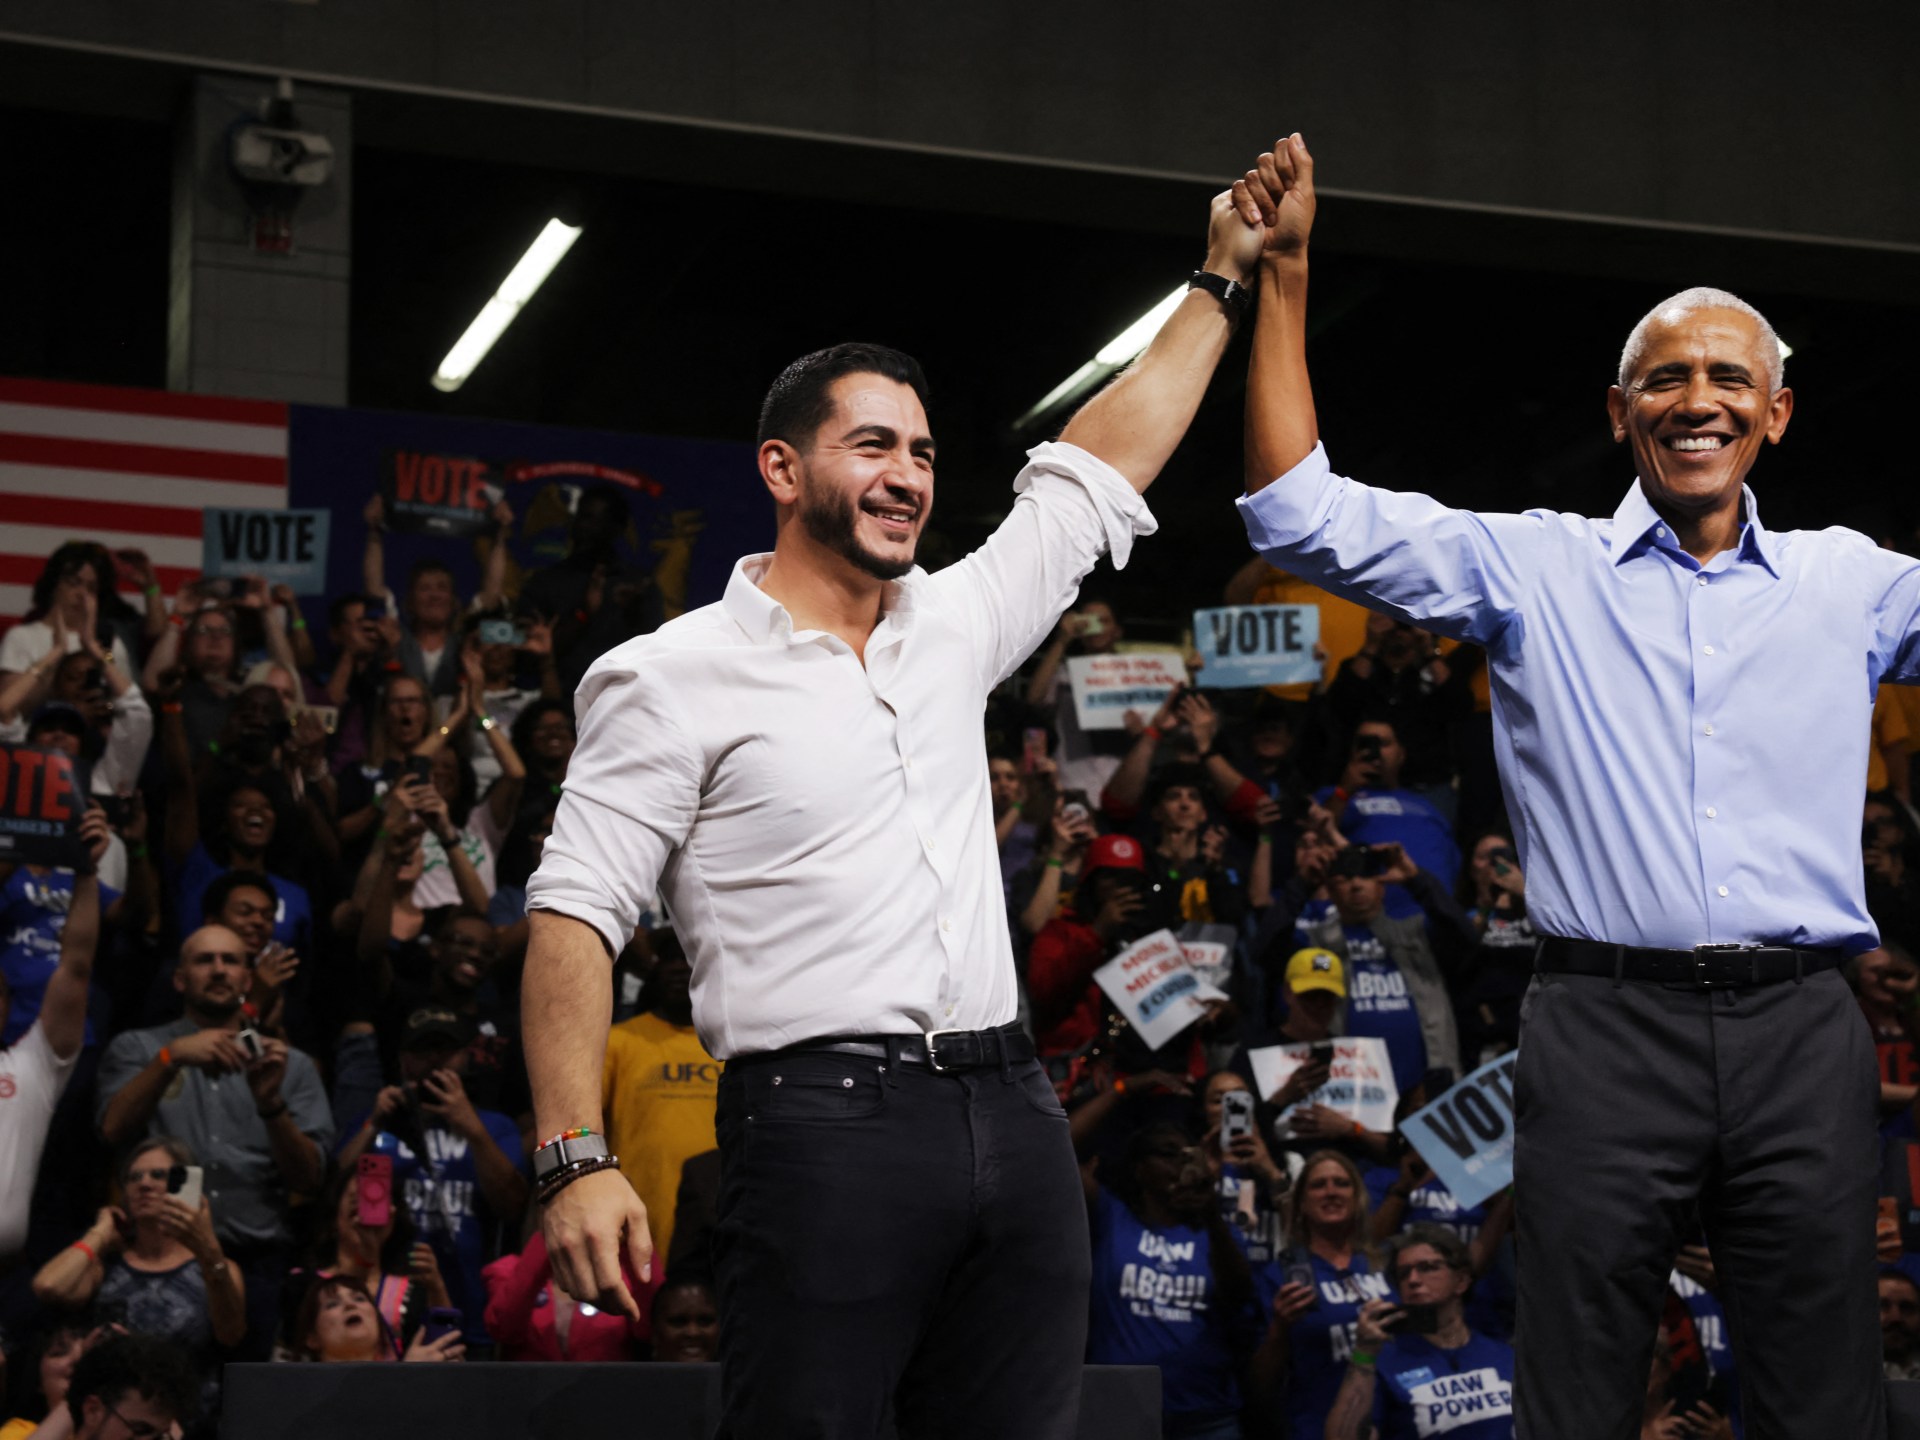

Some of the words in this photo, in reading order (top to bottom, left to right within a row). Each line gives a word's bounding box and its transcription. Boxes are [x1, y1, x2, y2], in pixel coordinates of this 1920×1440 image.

[395, 450, 489, 511] VOTE
[219, 513, 315, 562] VOTE
[1210, 609, 1303, 656] VOTE
[1138, 1229, 1195, 1263] UAW
[1120, 1263, 1208, 1310] ABDUL
[1319, 1271, 1392, 1304] UAW
[1431, 1374, 1484, 1398] UAW
